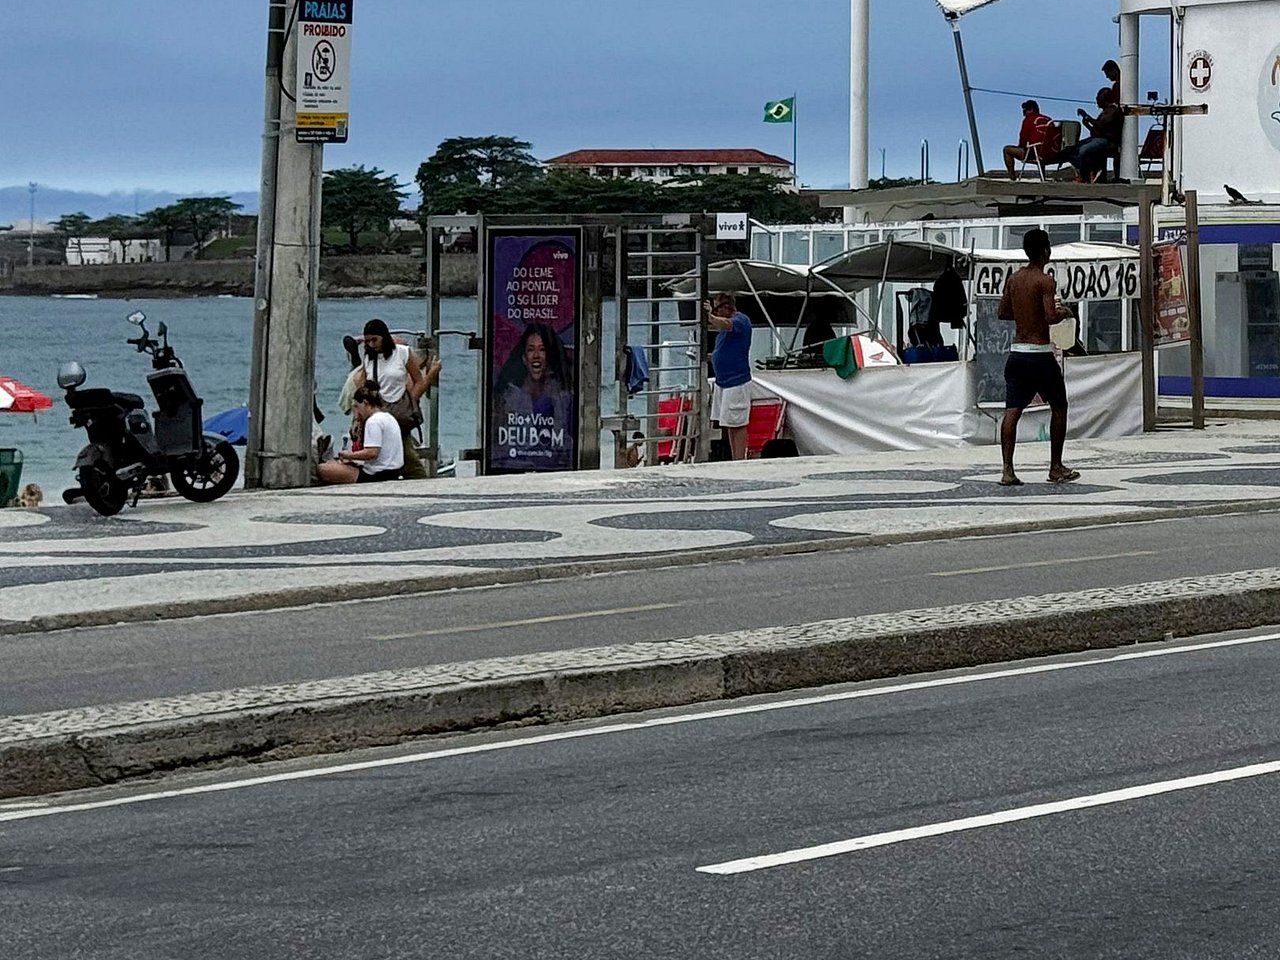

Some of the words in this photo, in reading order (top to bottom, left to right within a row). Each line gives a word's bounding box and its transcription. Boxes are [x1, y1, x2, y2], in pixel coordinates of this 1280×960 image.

[304, 0, 347, 19] PRAIAS
[303, 24, 346, 37] PROIBIDO
[718, 221, 738, 231] vivo
[552, 250, 569, 259] vivo
[513, 267, 527, 278] DO
[529, 267, 554, 278] LEME
[1115, 262, 1138, 297] 16
[506, 281, 520, 292] AO
[507, 294, 516, 305] O
[507, 308, 521, 319] DO
[498, 426, 527, 446] DEU
[529, 426, 564, 447] BOM
